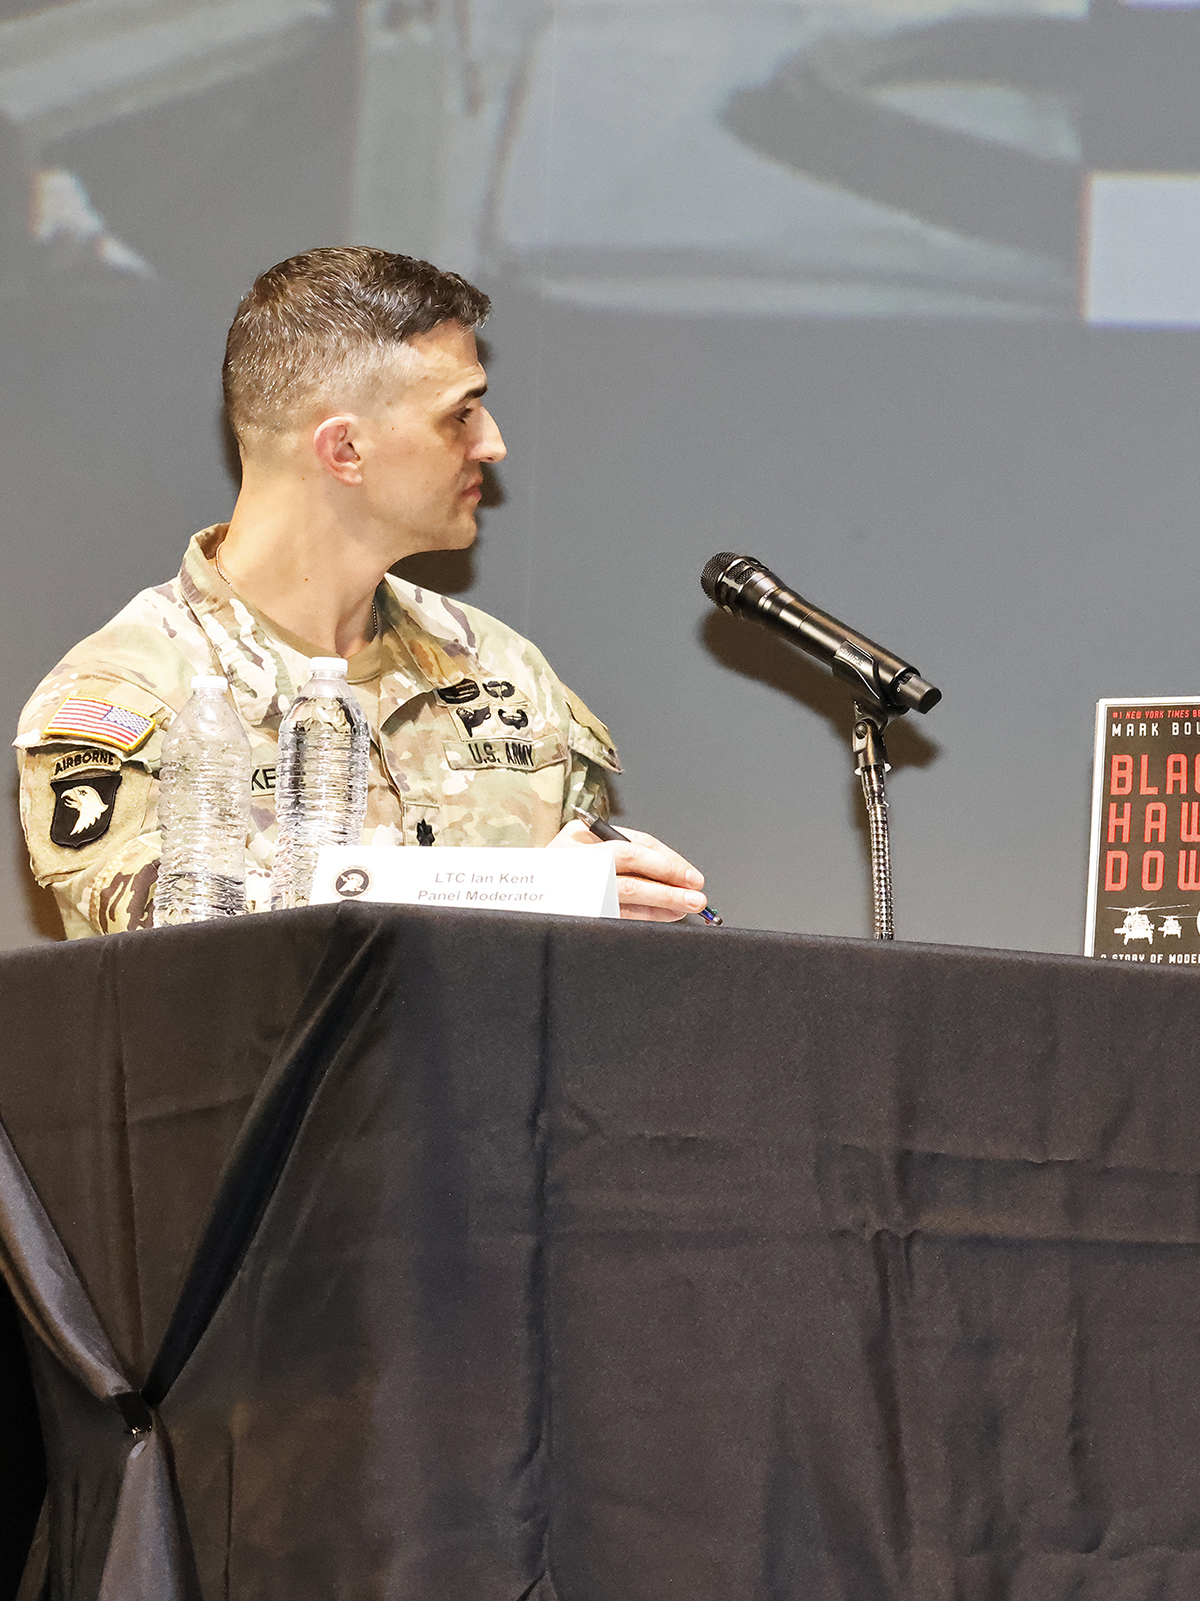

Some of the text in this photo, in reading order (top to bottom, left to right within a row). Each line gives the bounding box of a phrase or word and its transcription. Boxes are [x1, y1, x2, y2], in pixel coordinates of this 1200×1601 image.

[1125, 710, 1143, 719] NEW
[1145, 710, 1164, 719] YORK
[1167, 709, 1190, 718] TIMES
[1112, 722, 1159, 737] MARK
[468, 742, 534, 767] U.S. ARMY
[54, 750, 114, 776] AIRBORNE
[435, 872, 534, 884] LTC Ian Kent
[418, 890, 545, 902] Panel Moderator
[1150, 953, 1164, 964] OF
